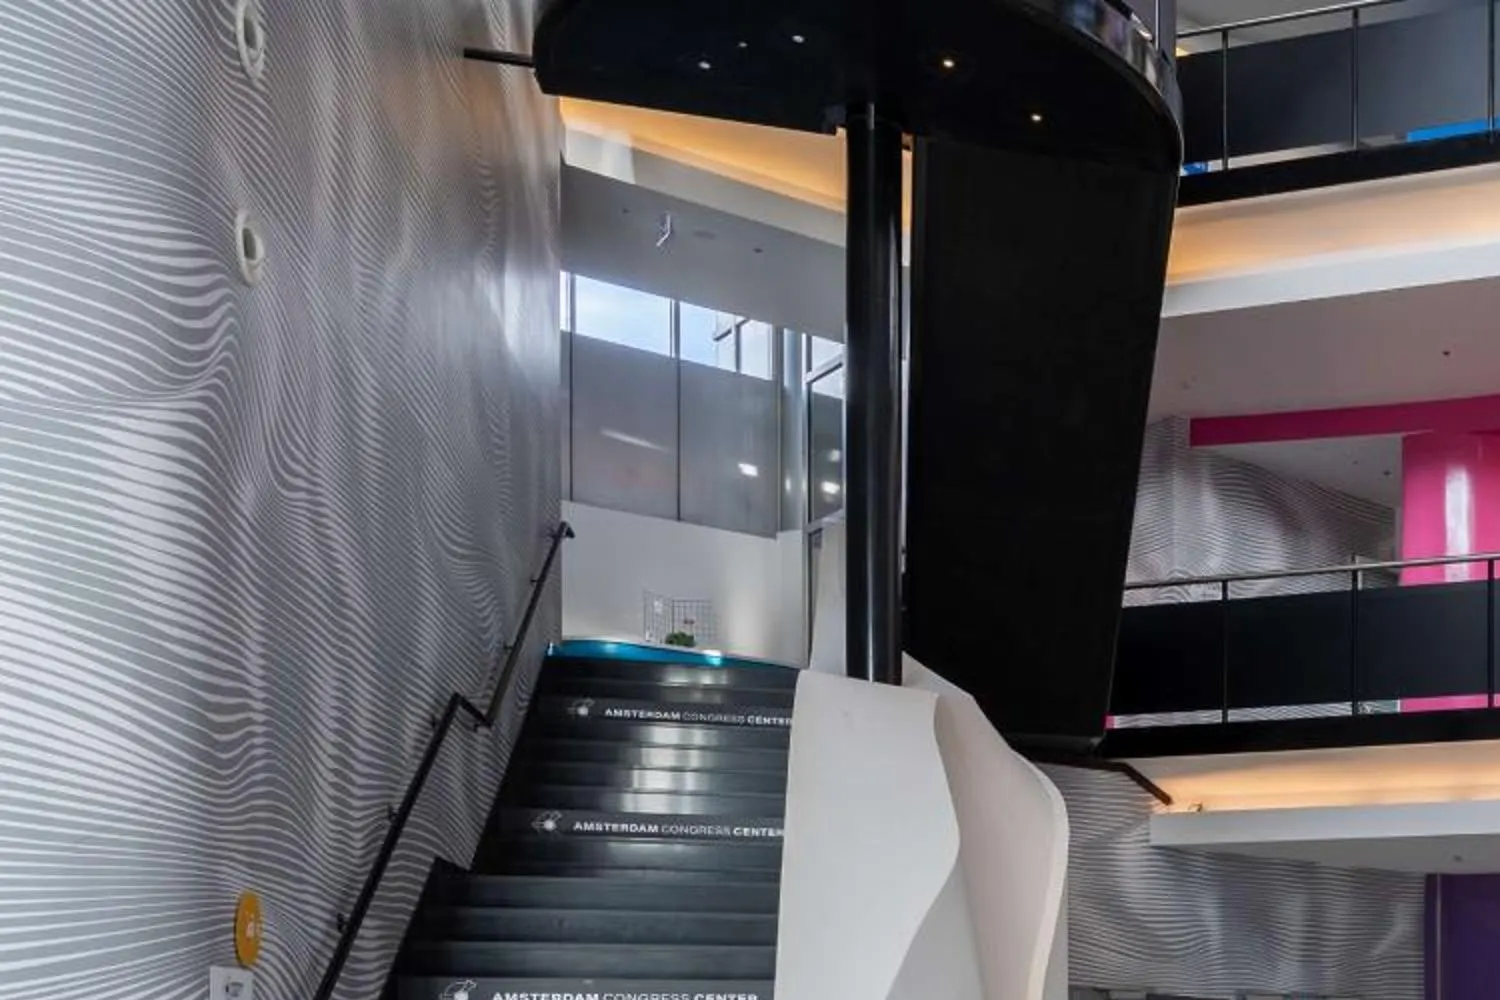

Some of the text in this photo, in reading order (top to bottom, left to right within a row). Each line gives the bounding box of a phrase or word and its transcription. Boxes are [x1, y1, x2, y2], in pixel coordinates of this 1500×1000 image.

[604, 708, 681, 720] AMSTERDAM
[682, 712, 744, 724] CONGRESS
[573, 821, 659, 834] AMSTERDAM
[661, 824, 730, 836] CONGRESS
